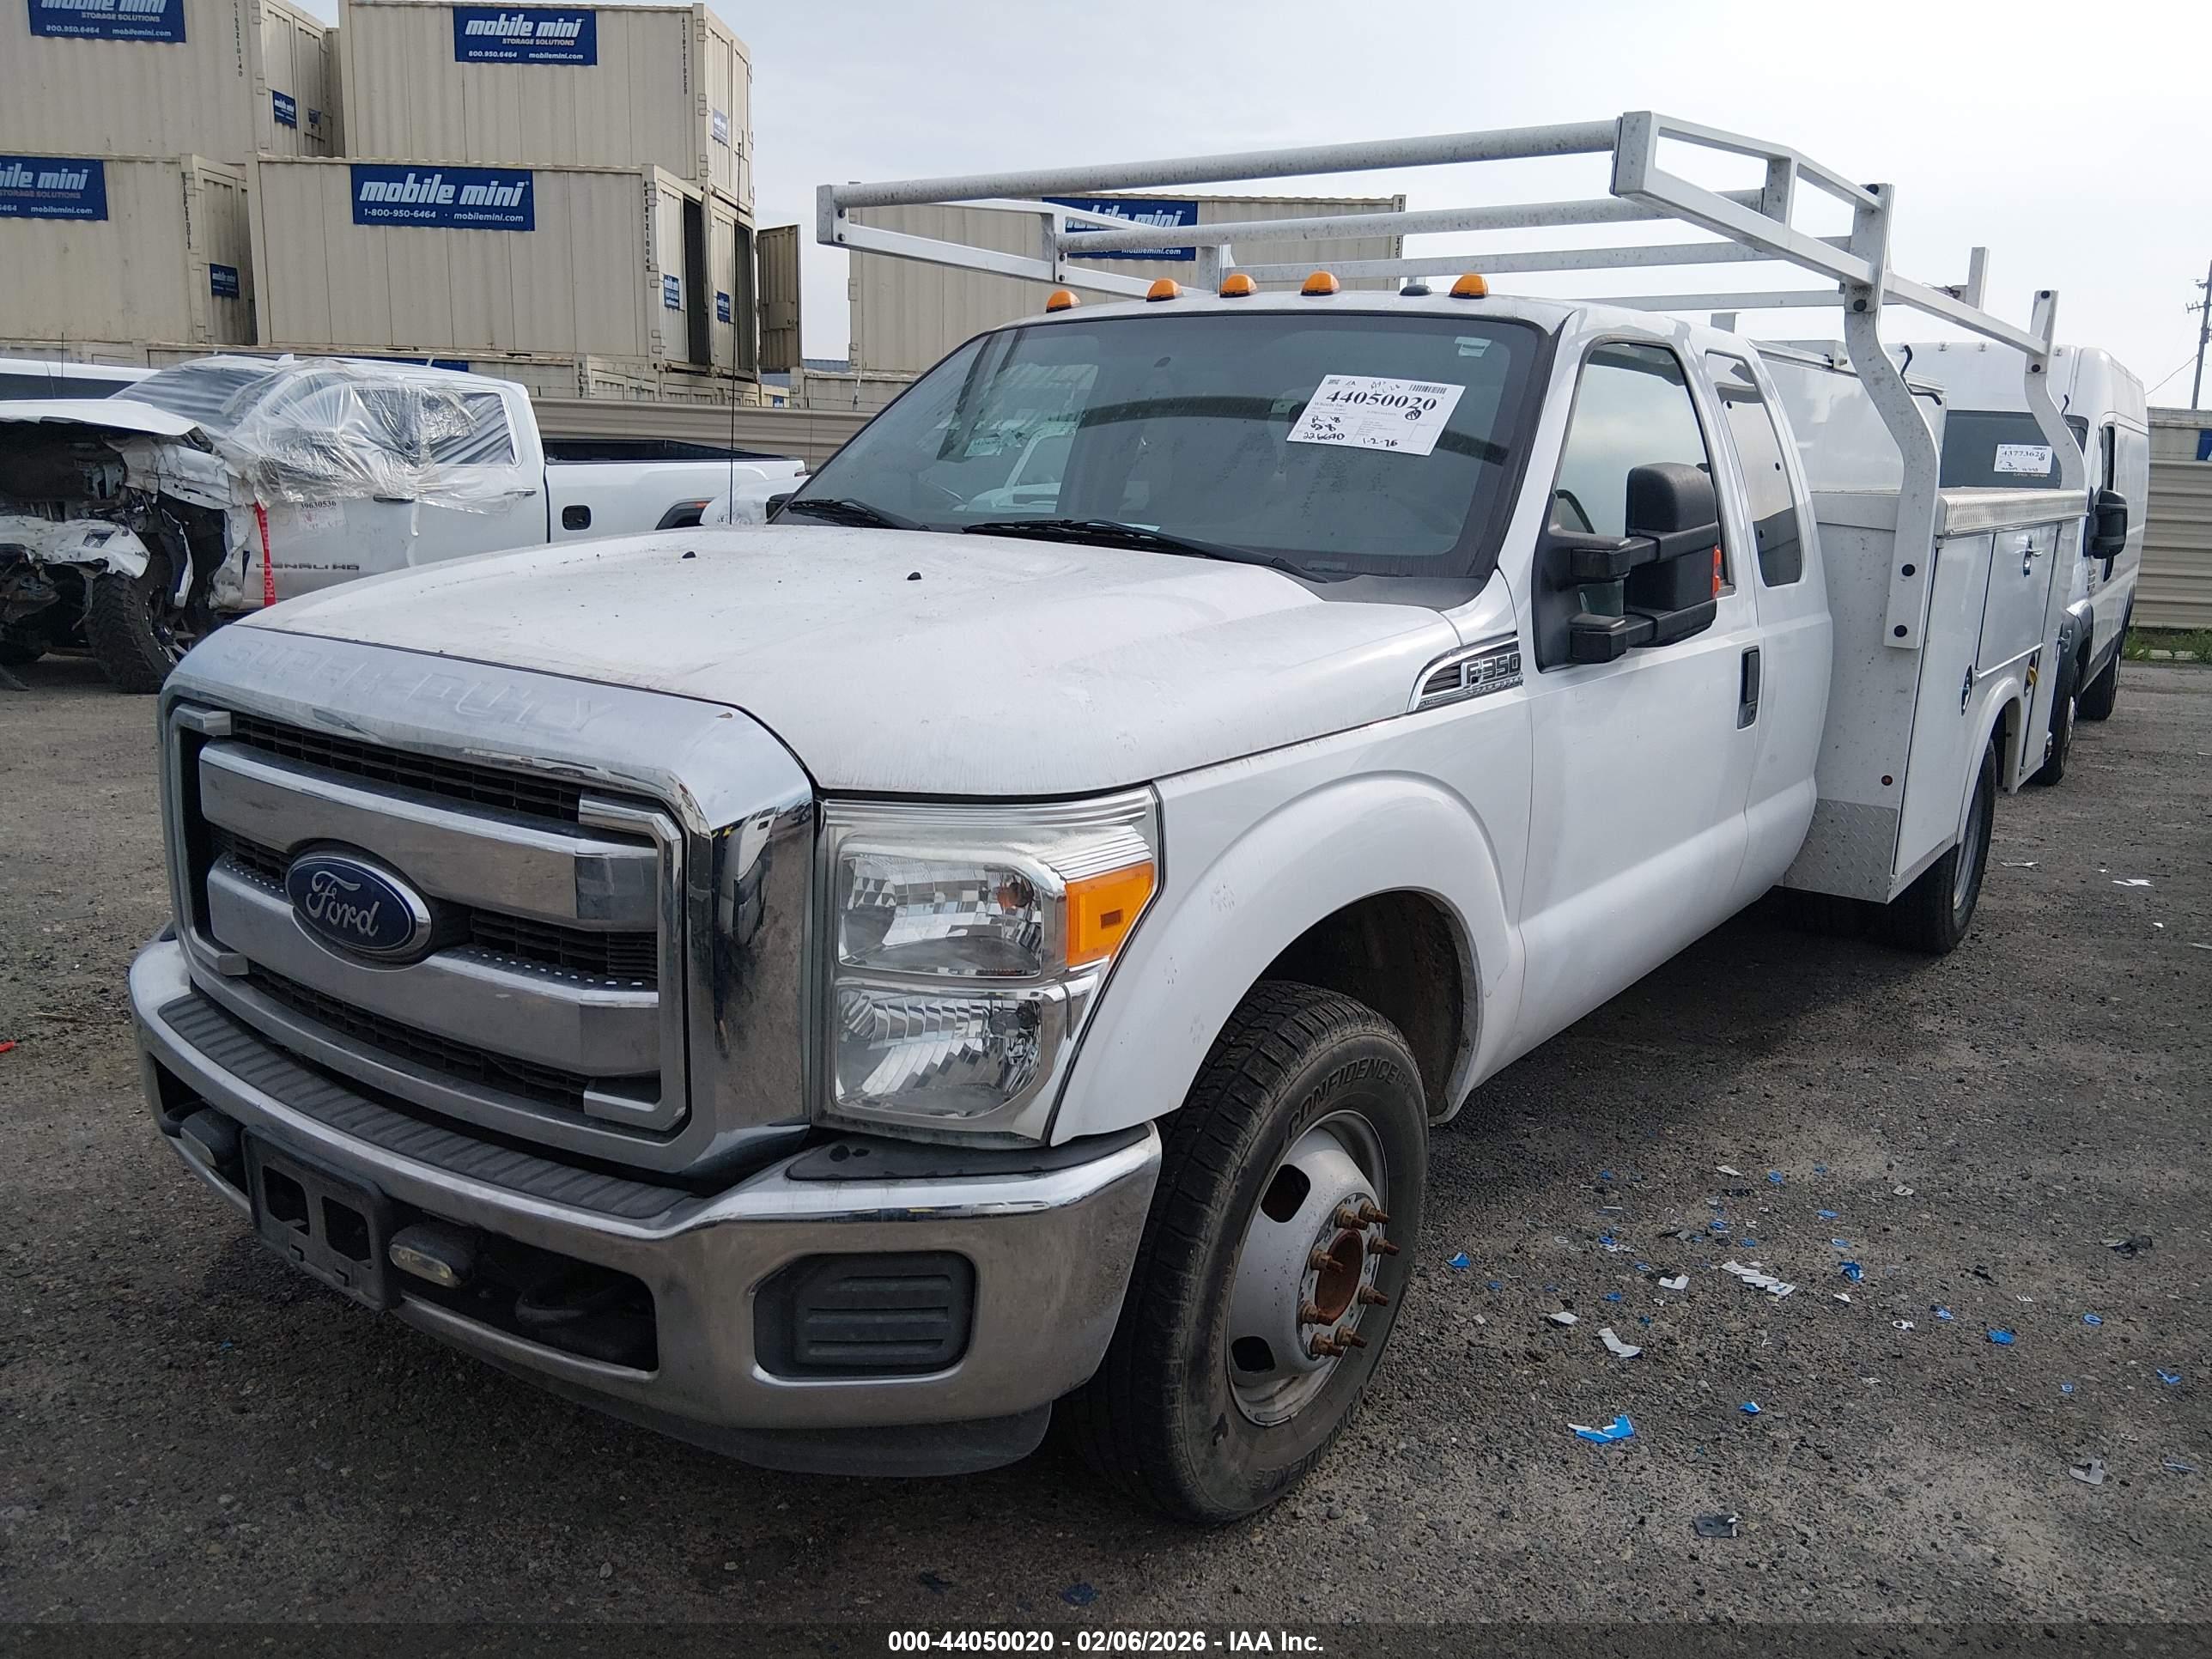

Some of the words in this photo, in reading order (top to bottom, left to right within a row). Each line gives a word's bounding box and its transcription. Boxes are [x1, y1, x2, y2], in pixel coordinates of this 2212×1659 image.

[118, 13, 161, 22] SOLUTIONS
[465, 14, 534, 36] mobile
[536, 18, 582, 38] mini
[37, 168, 89, 190] mini
[359, 173, 456, 204] mobile
[459, 180, 526, 207] mini
[364, 209, 436, 218] 1-800-950-6464
[453, 213, 524, 222] mobilemini.com
[1326, 391, 1437, 411] 44050020
[306, 870, 380, 938] Ford
[1287, 1057, 1401, 1139] CONFIDENCE
